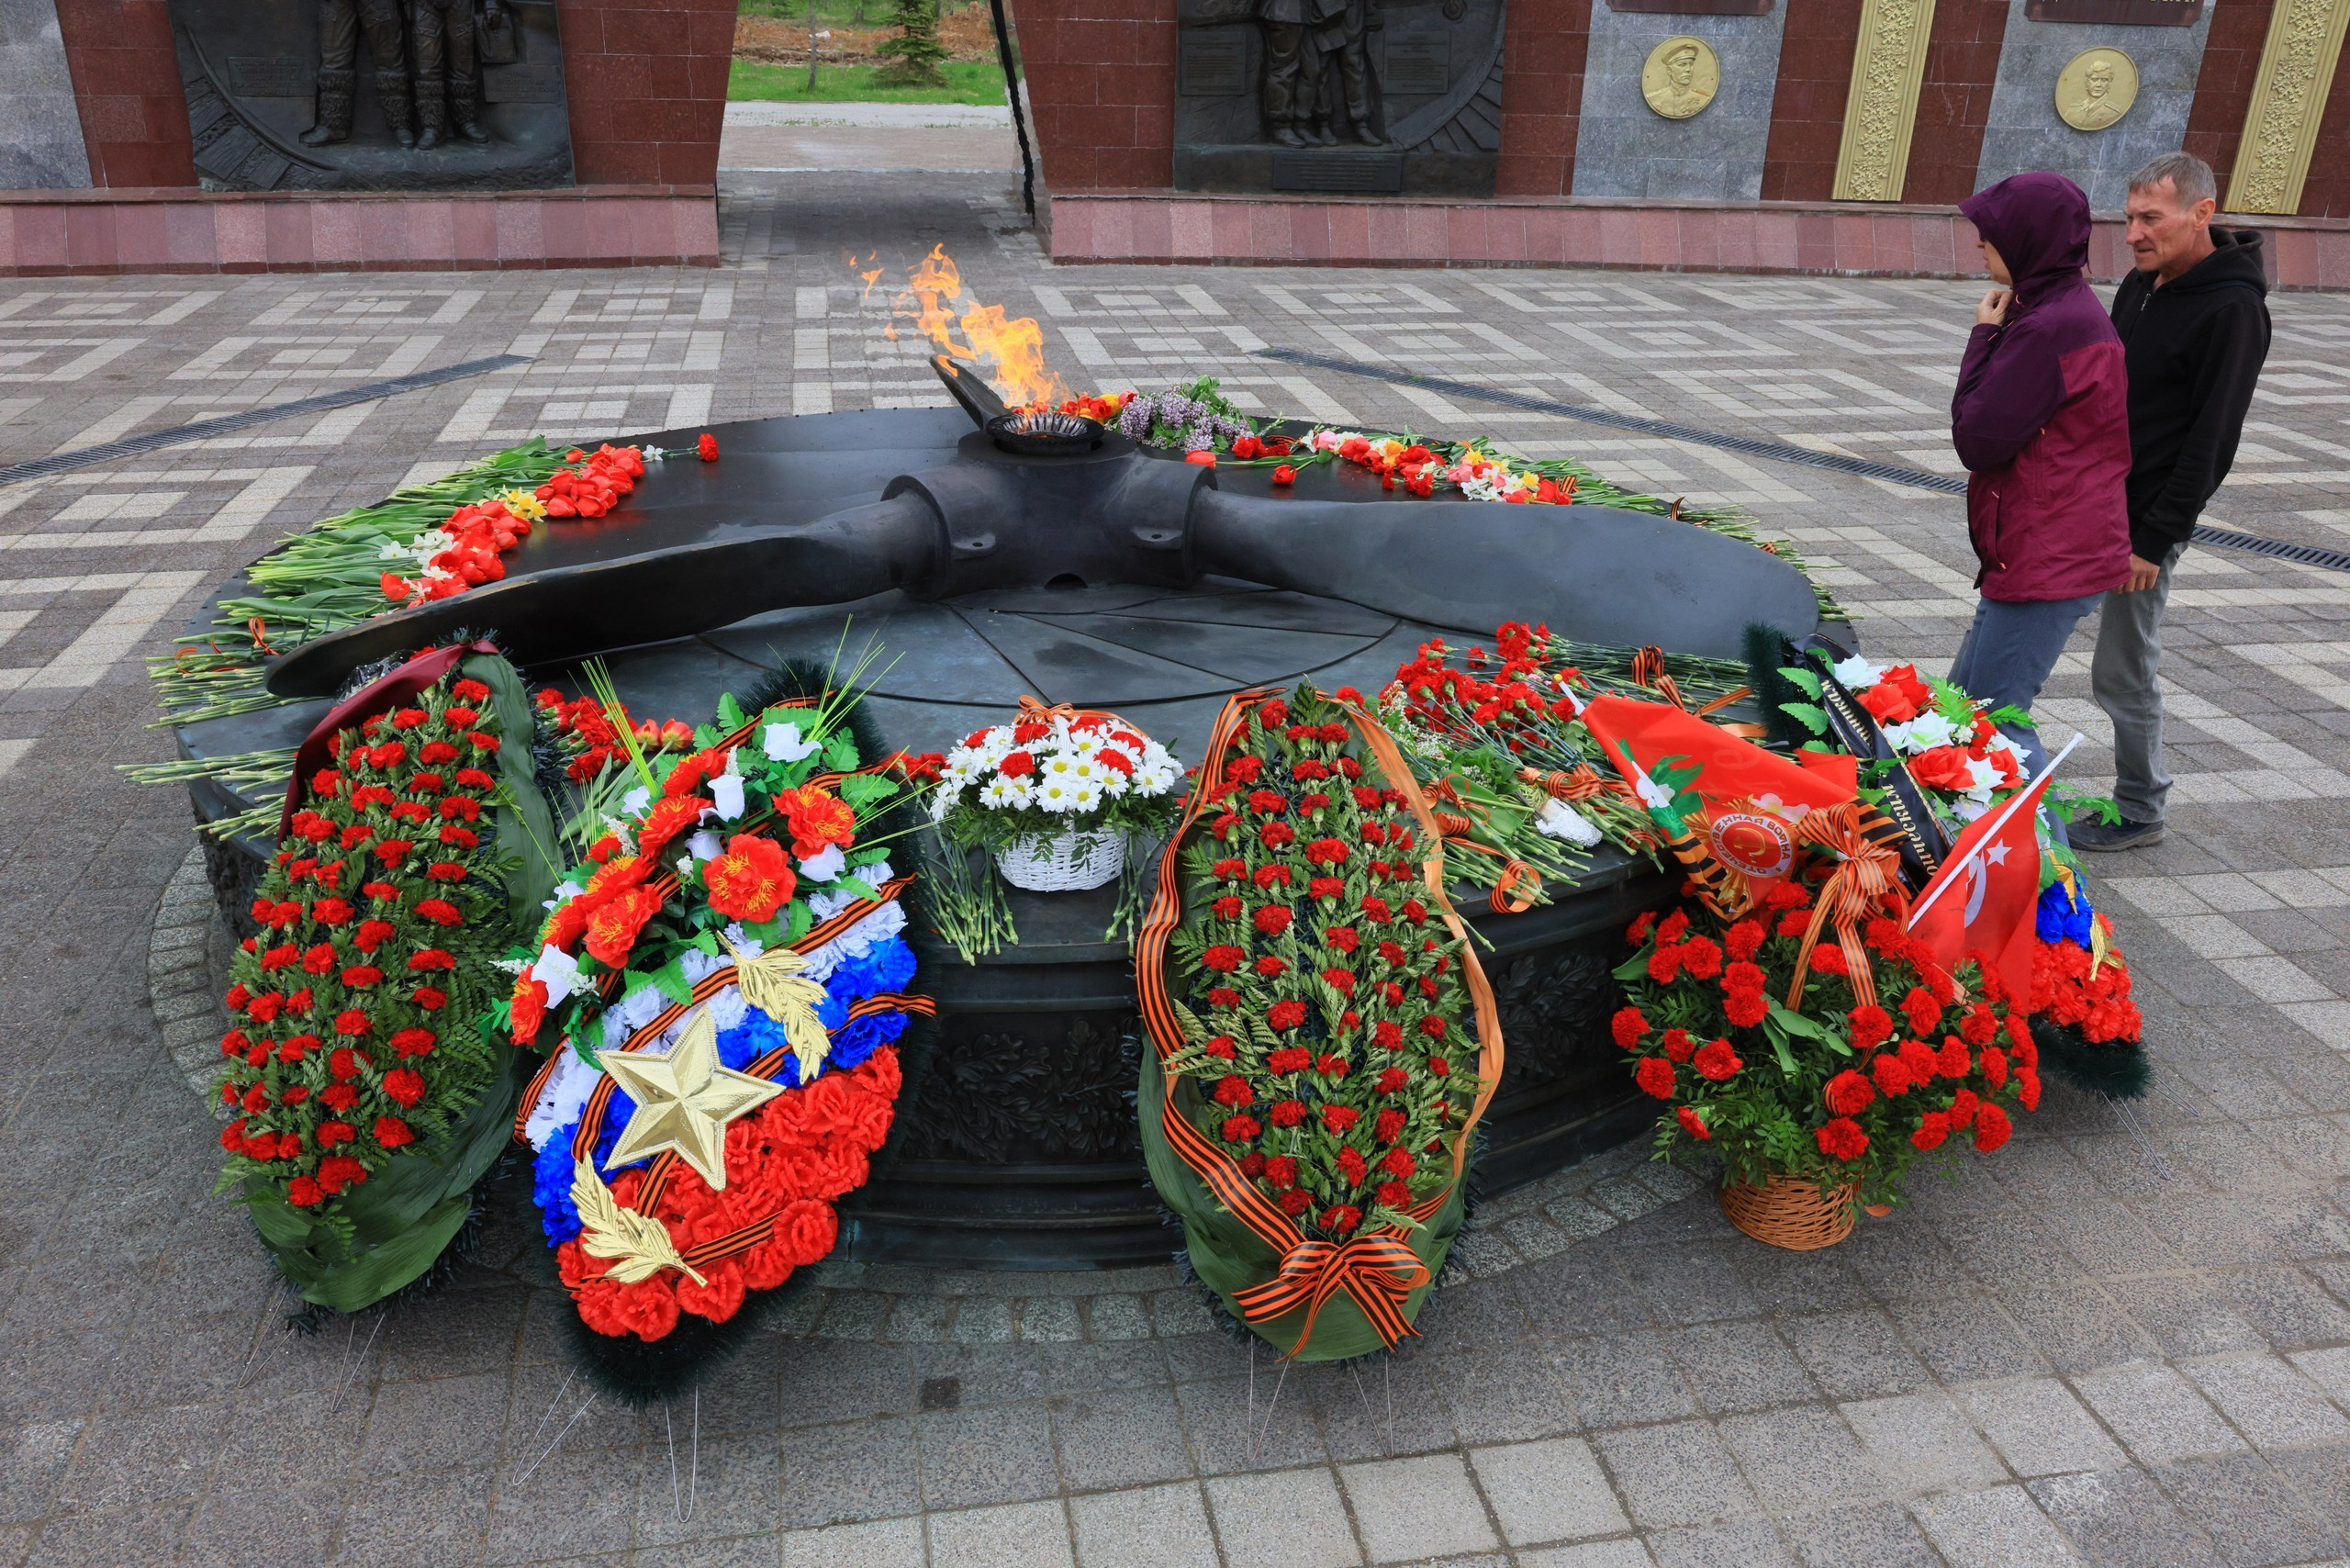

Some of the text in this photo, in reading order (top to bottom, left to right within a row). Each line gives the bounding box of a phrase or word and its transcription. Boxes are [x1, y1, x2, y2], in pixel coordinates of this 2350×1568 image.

[1820, 679, 1940, 877] оическим тникам
[1712, 814, 1767, 875] ОТЕЧЕСТВЕННАЯ
